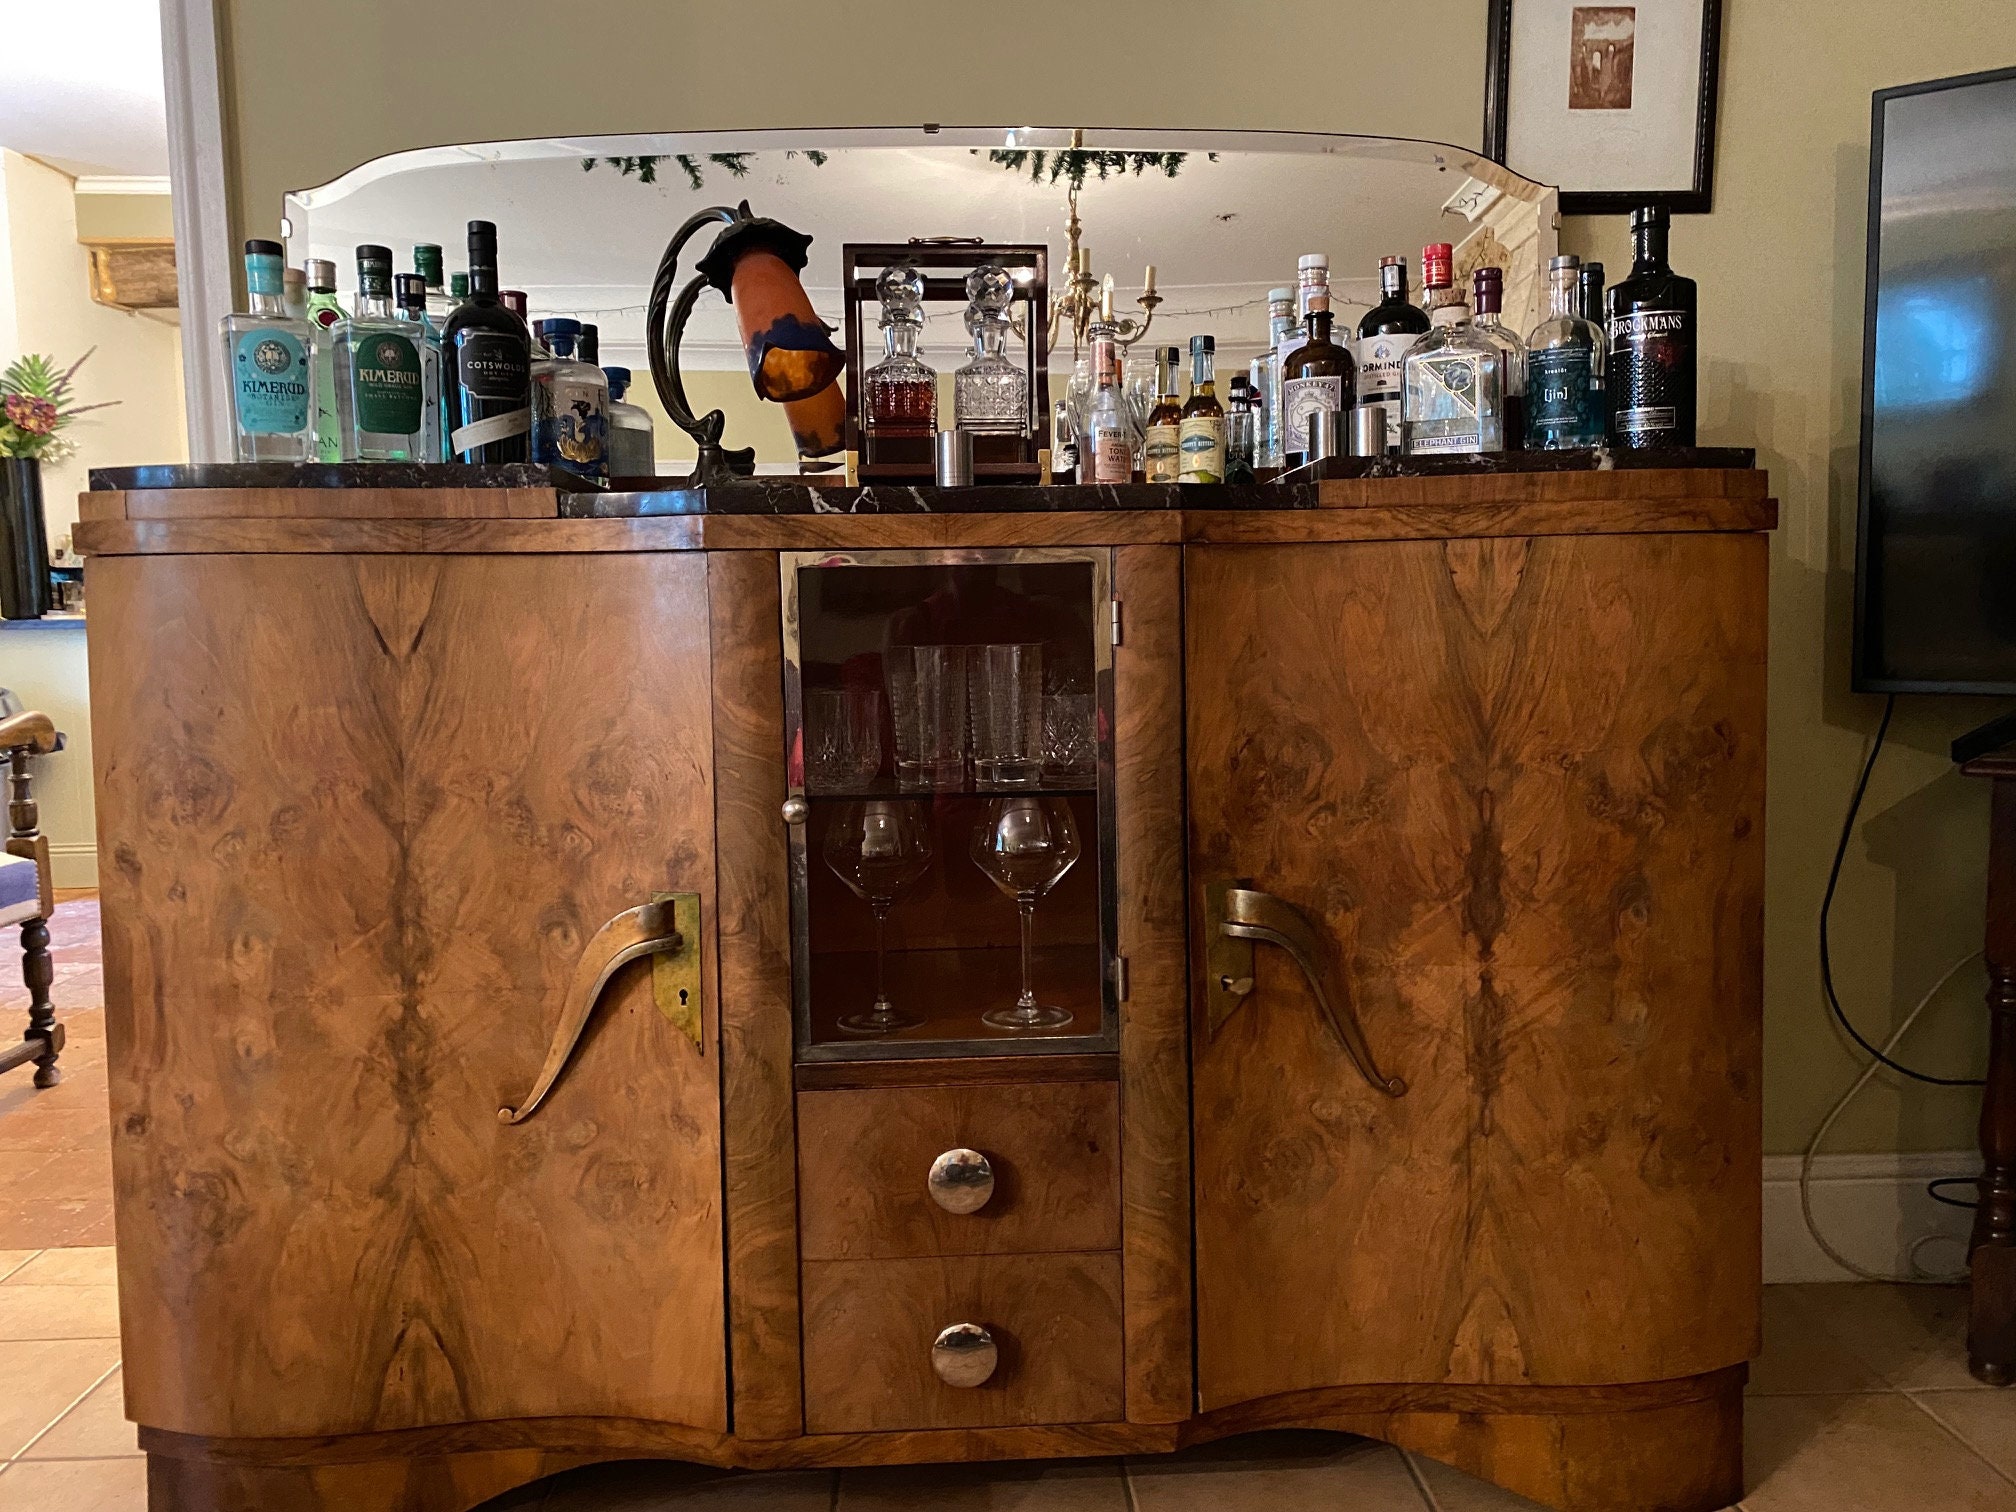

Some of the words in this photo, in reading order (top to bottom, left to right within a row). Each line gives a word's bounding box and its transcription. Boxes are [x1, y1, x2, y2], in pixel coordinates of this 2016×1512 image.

[1609, 315, 1682, 339] BROCKMANS
[467, 361, 525, 373] COTSWOLDS
[1359, 361, 1401, 373] ORMIND
[359, 368, 419, 385] KIMERUD
[242, 380, 305, 395] KIMERUD
[1288, 381, 1323, 395] MONKEY
[1544, 386, 1568, 403] [jin]
[1414, 437, 1457, 448] ELEPHANT
[1460, 436, 1476, 444] GIN
